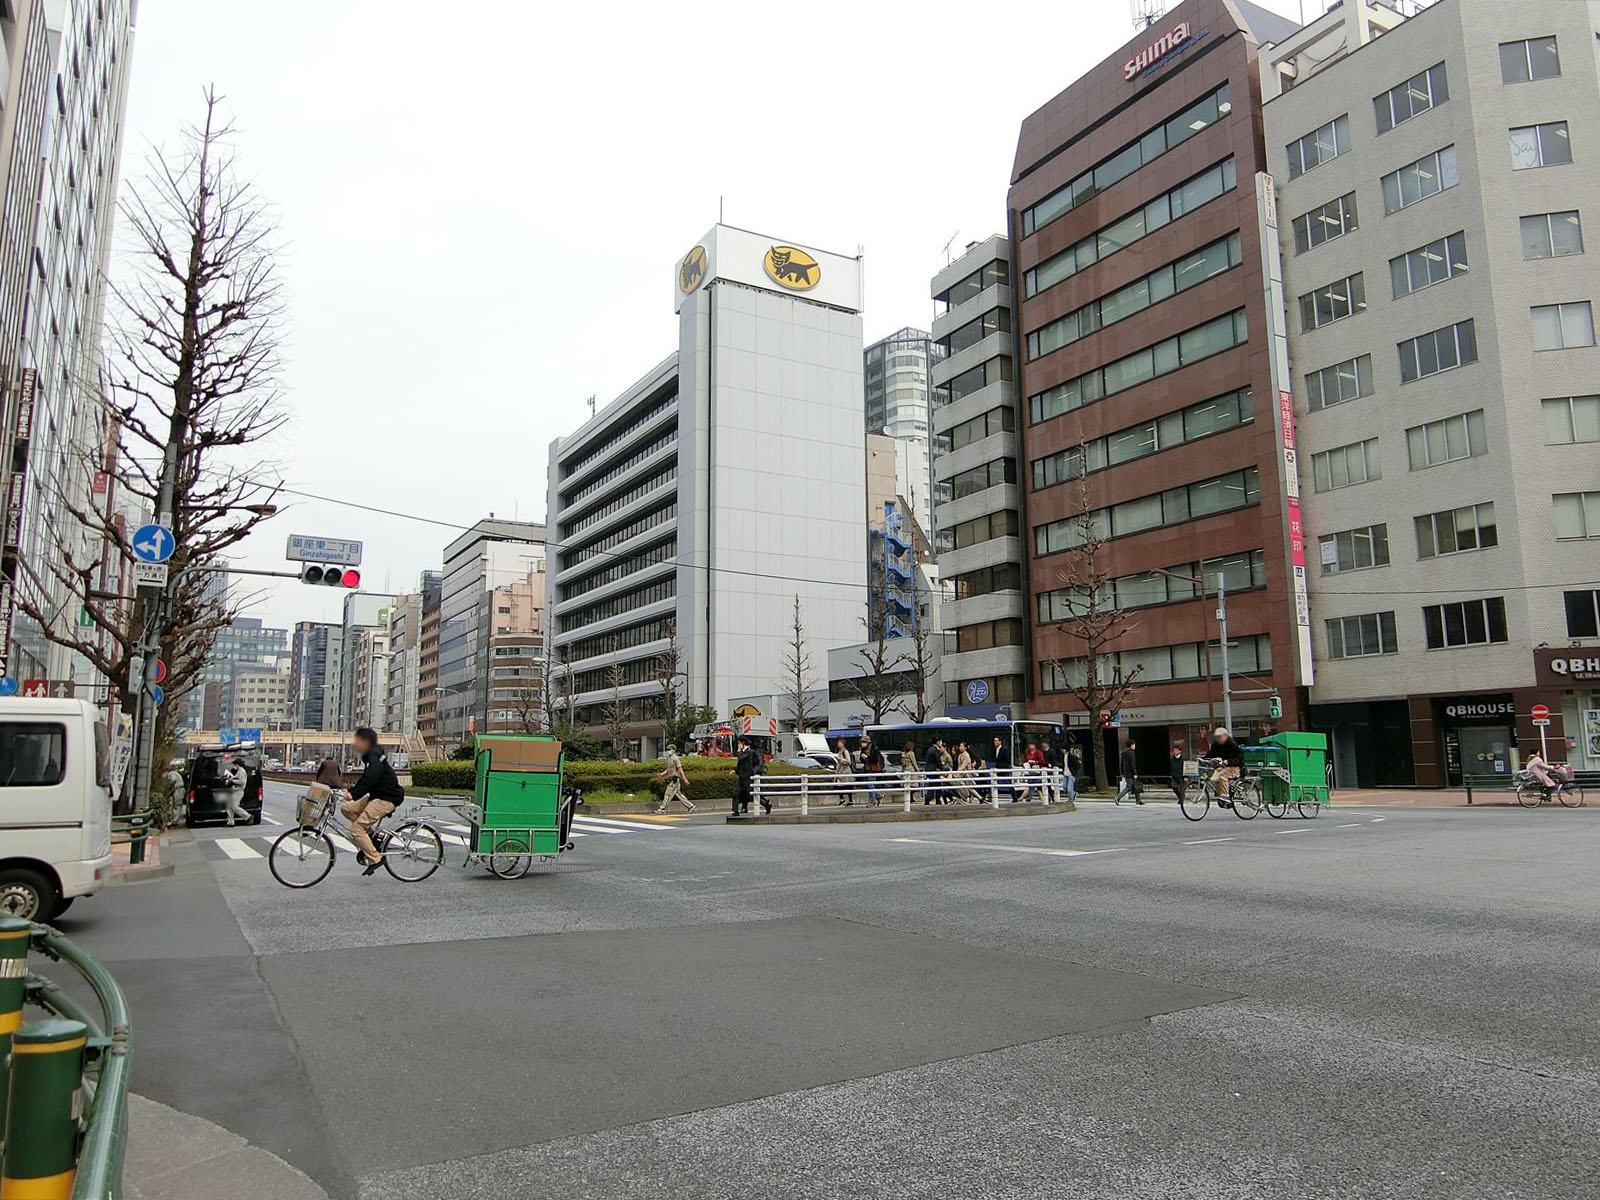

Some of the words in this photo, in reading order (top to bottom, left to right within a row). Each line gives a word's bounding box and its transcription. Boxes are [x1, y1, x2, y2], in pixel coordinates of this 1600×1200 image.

[291, 537, 360, 553] 銀座東二丁目
[299, 549, 345, 561] Ginzahigashi
[346, 553, 352, 561] 2
